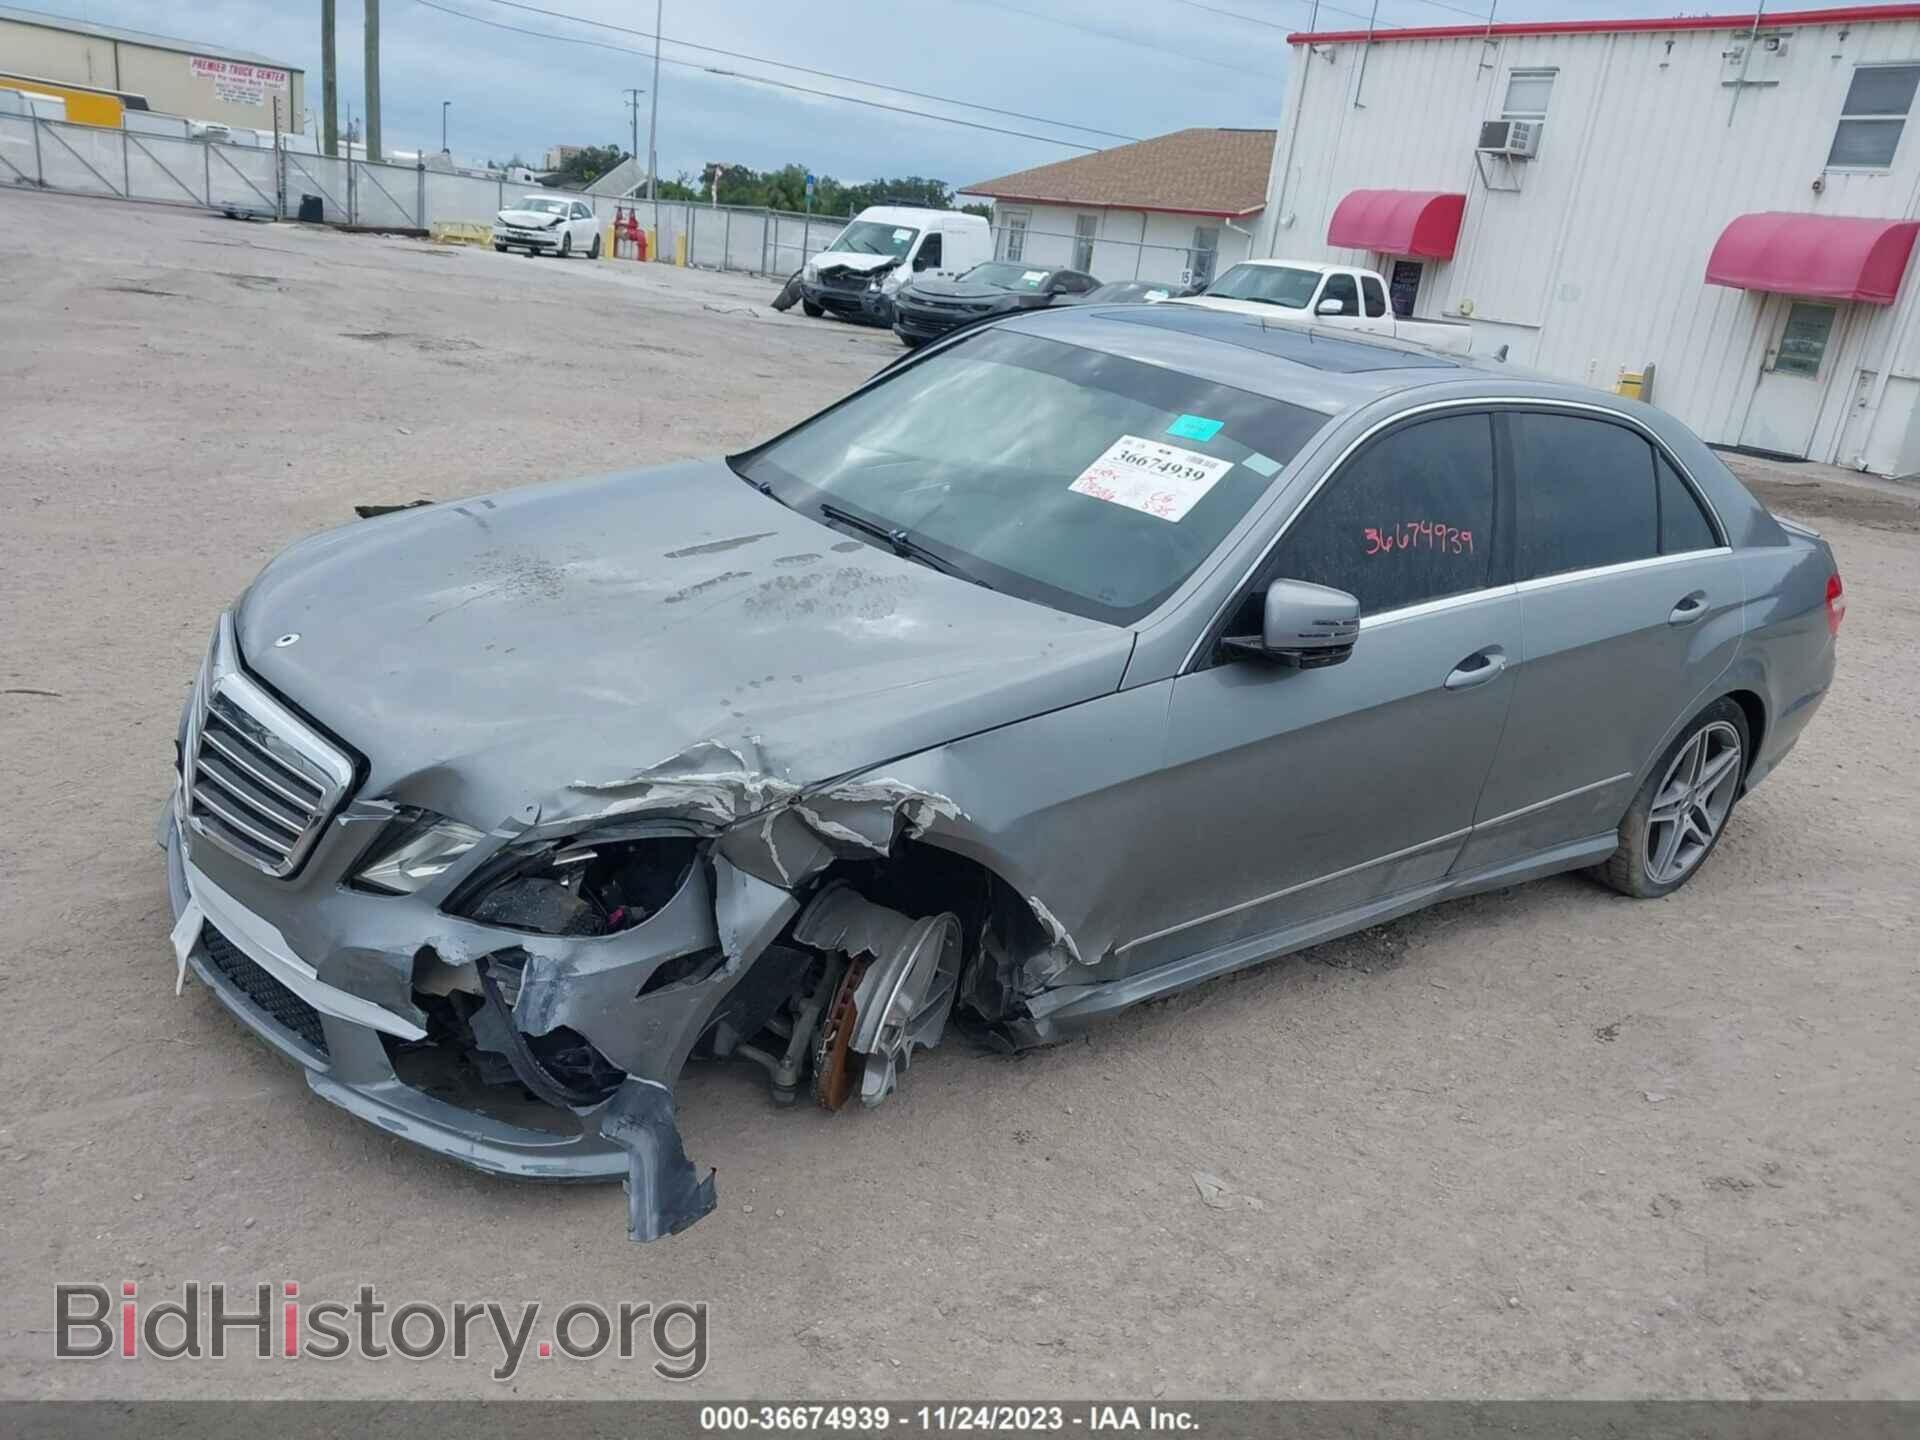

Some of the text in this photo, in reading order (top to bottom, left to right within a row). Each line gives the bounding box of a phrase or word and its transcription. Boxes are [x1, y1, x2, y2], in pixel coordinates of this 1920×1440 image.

[192, 58, 285, 81] PREMIER TRUCK CENTER
[1113, 449, 1206, 481] 36674939
[1364, 520, 1473, 554] 36674939
